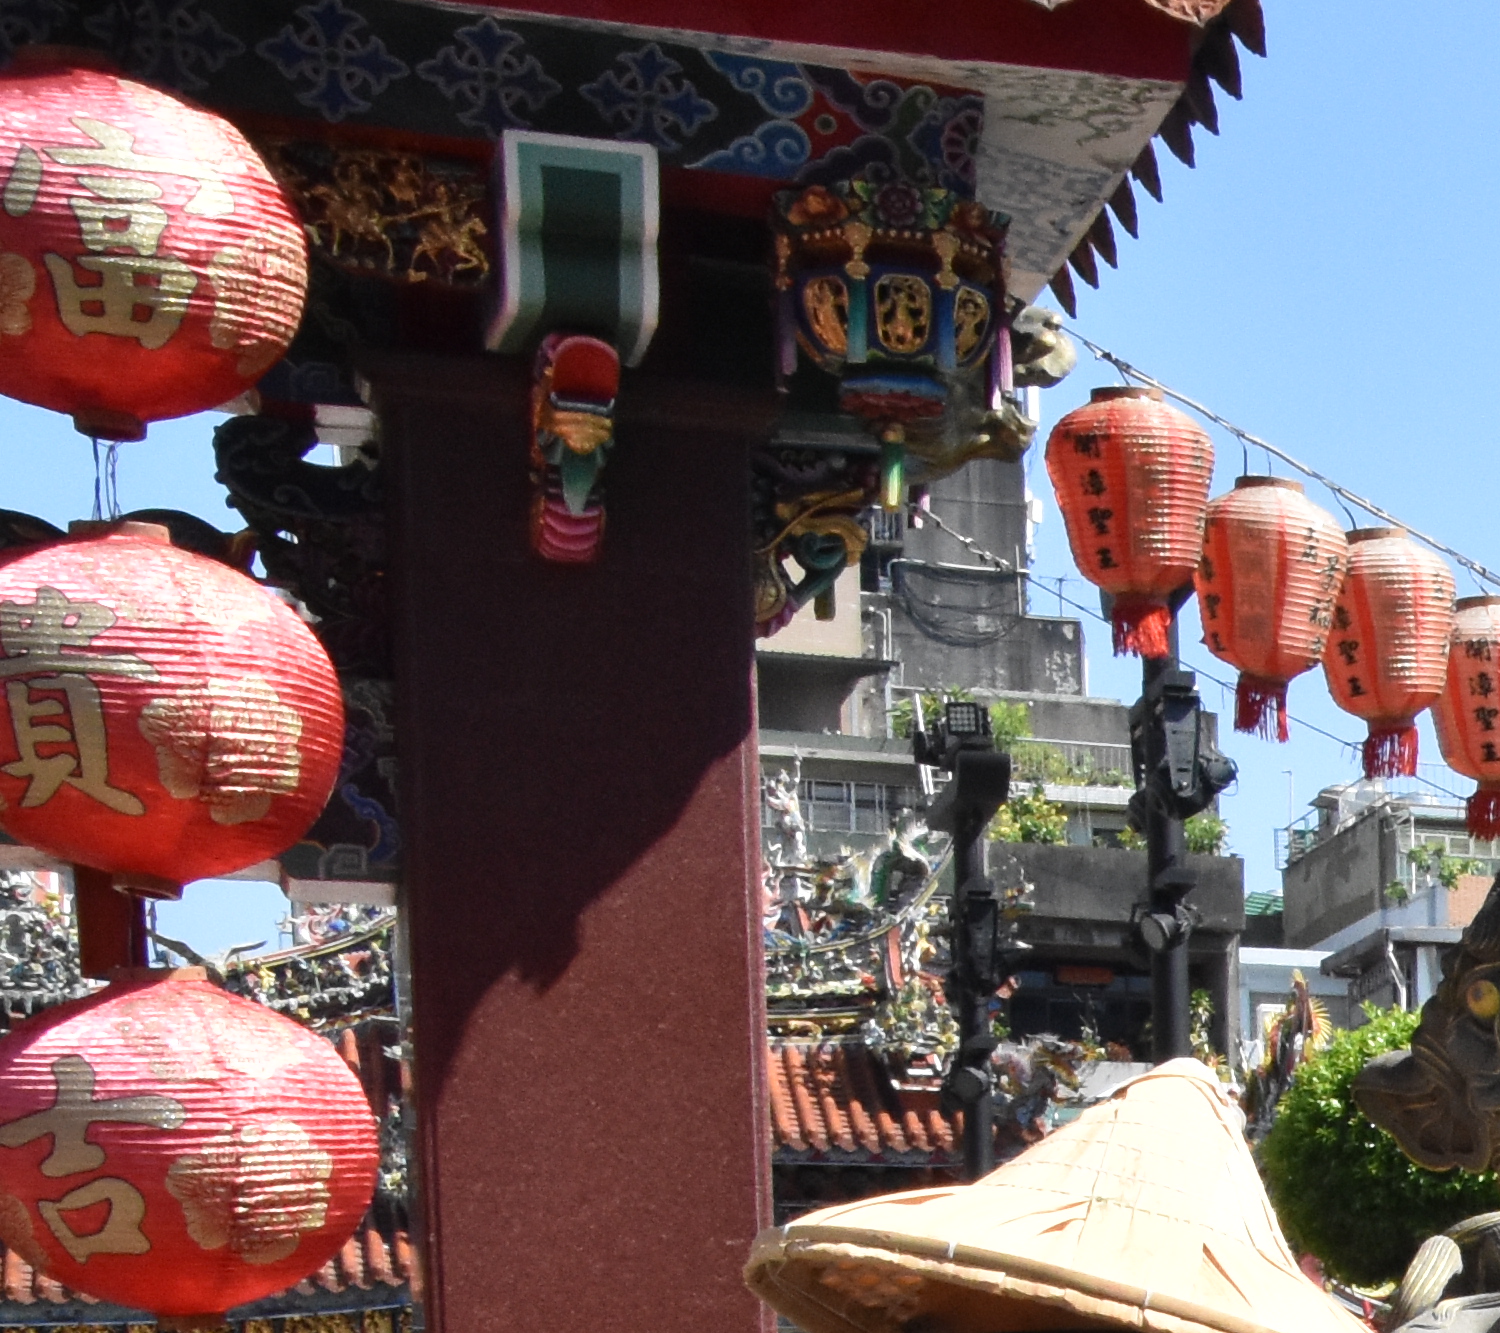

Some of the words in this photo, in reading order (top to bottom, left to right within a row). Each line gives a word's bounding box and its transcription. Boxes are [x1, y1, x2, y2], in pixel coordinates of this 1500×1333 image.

[3, 116, 233, 350] 富
[0, 587, 160, 816] 貴
[1466, 637, 1500, 762] 開漳聖王
[0, 1055, 188, 1264] 吉
